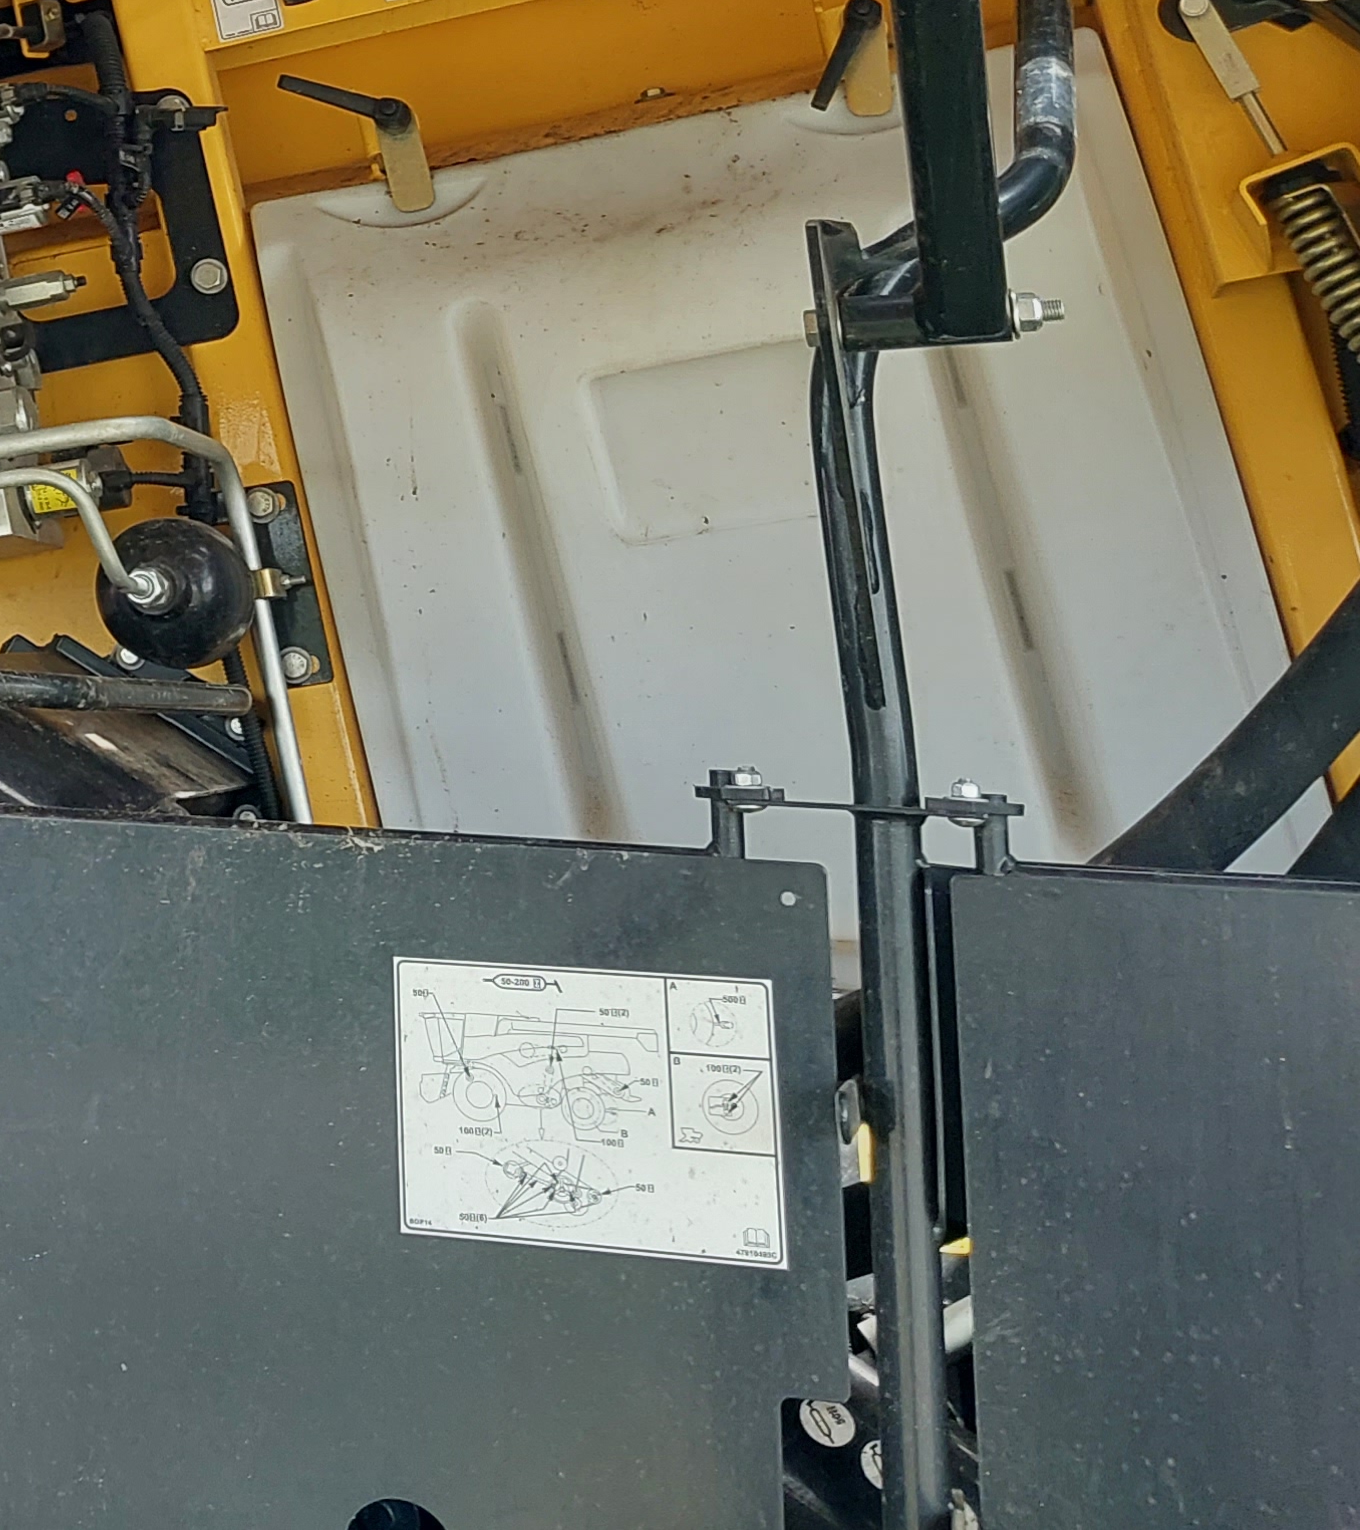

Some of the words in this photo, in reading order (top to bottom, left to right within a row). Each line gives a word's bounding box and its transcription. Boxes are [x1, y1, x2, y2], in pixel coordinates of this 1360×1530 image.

[669, 981, 678, 990] A
[647, 1107, 656, 1116] A
[620, 1129, 629, 1138] B
